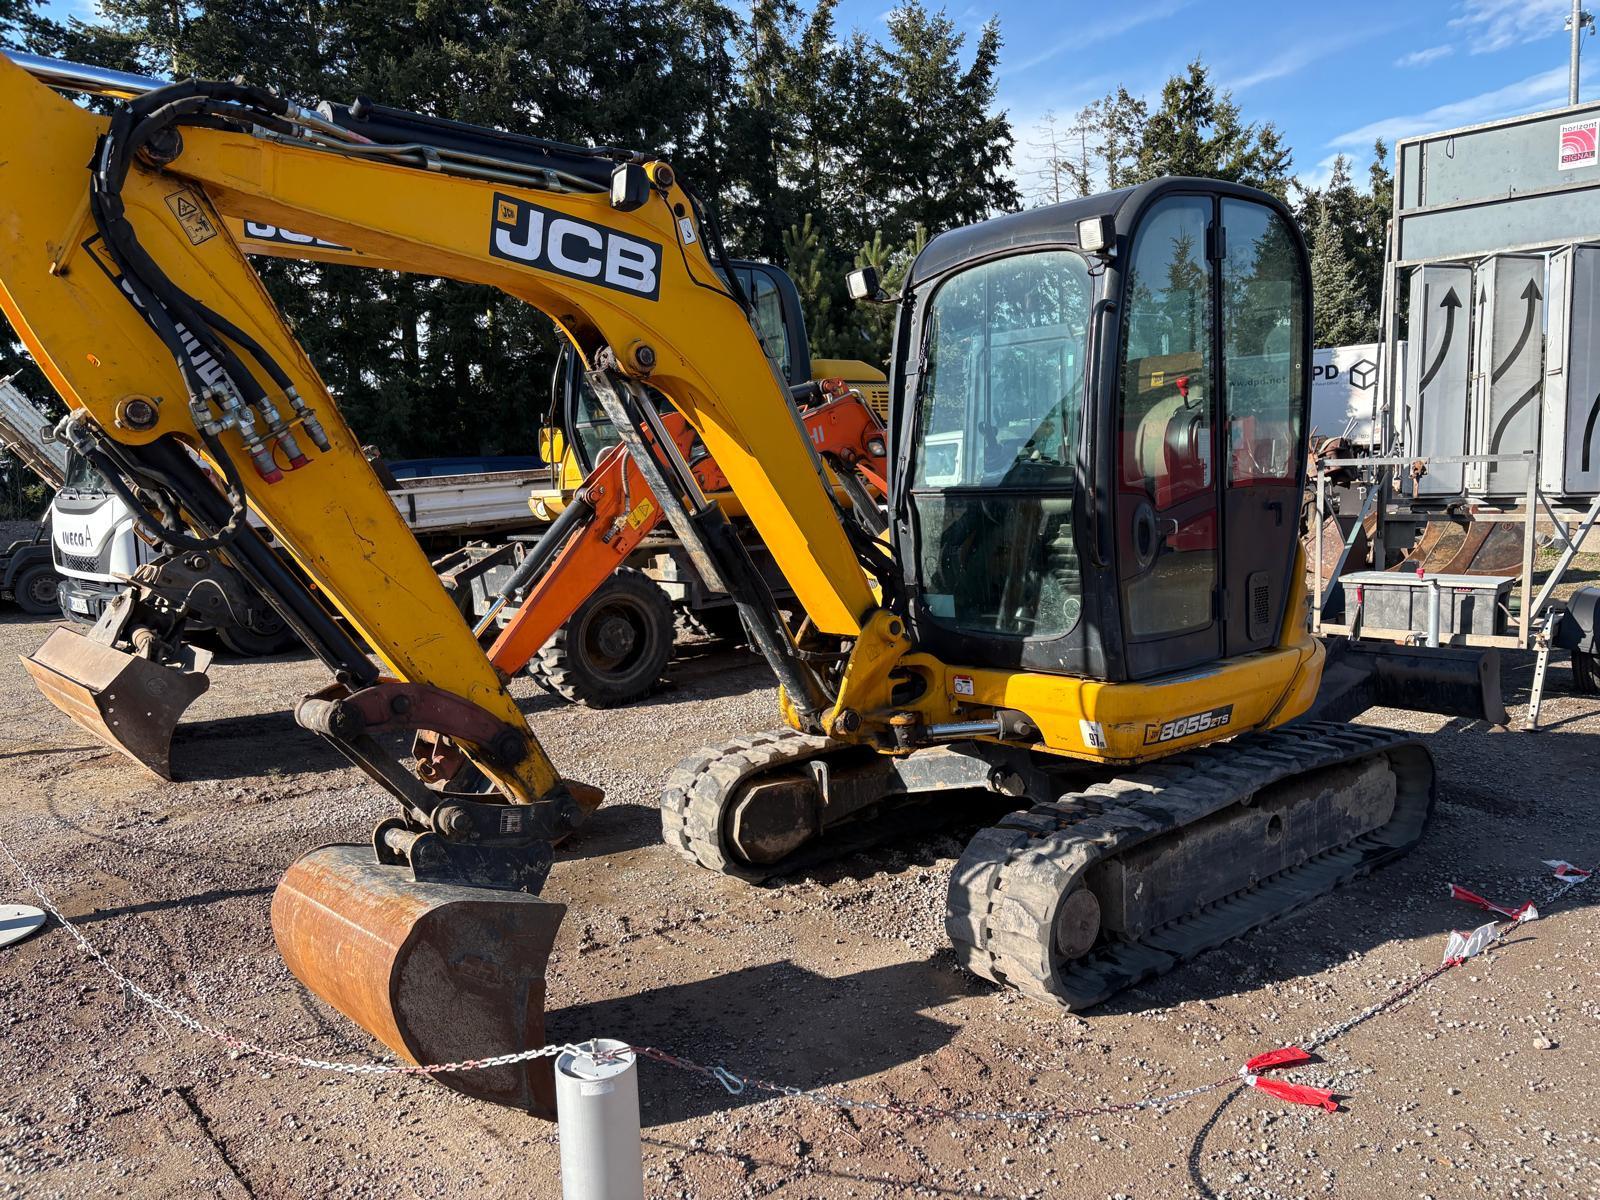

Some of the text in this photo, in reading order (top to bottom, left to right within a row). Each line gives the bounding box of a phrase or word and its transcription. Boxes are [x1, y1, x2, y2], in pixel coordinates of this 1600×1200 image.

[1562, 121, 1597, 132] horizont
[496, 209, 656, 293] JCB
[1313, 365, 1339, 380] PD
[62, 531, 84, 547] IVECO
[1089, 732, 1100, 747] 97
